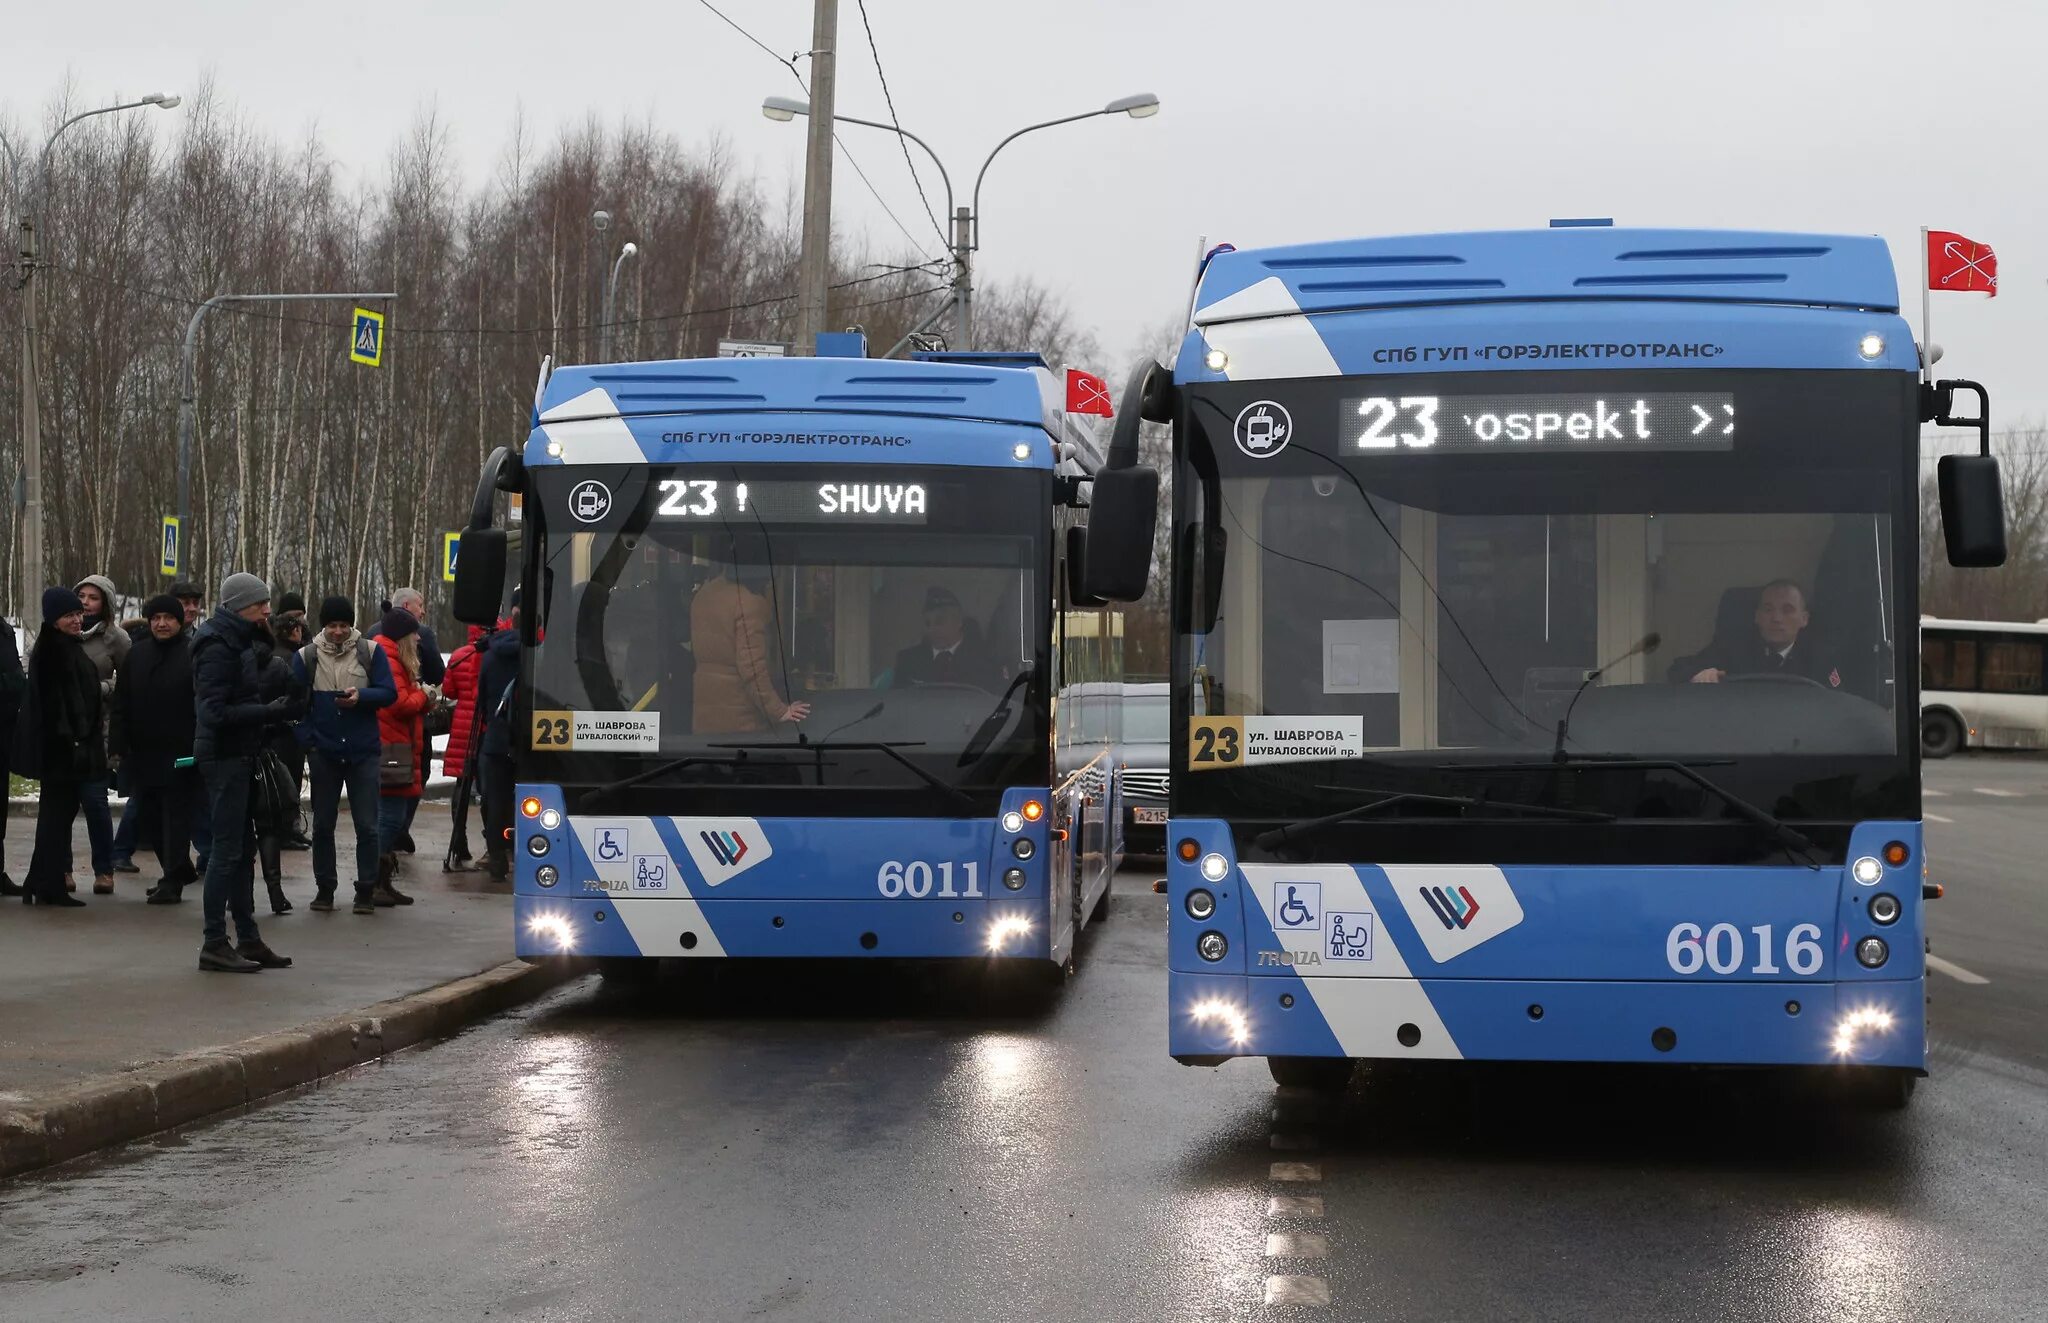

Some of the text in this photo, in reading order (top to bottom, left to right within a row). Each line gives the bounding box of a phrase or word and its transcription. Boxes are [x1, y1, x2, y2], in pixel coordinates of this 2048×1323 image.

[1373, 343, 1724, 363] СПб ГУП «ГОРЭЛЕКТРОТРАНС»
[1357, 397, 1439, 449] 23
[661, 432, 912, 447] СПб ГУП «ГОРЭЛЕКТРОТРАНС»
[658, 480, 718, 516] 23
[818, 484, 925, 514] SHUVA
[535, 718, 570, 745] 23
[576, 723, 591, 731] ул.
[595, 722, 646, 730] ШАВРОВА
[1249, 732, 1269, 743] ул.
[1274, 730, 1344, 741] ШАВРОВА
[1193, 726, 1240, 763] 23
[1248, 745, 1358, 758] ШУВАЛОВСКИЙ пр.
[877, 860, 983, 898] 6011
[1666, 922, 1824, 975] 6016
